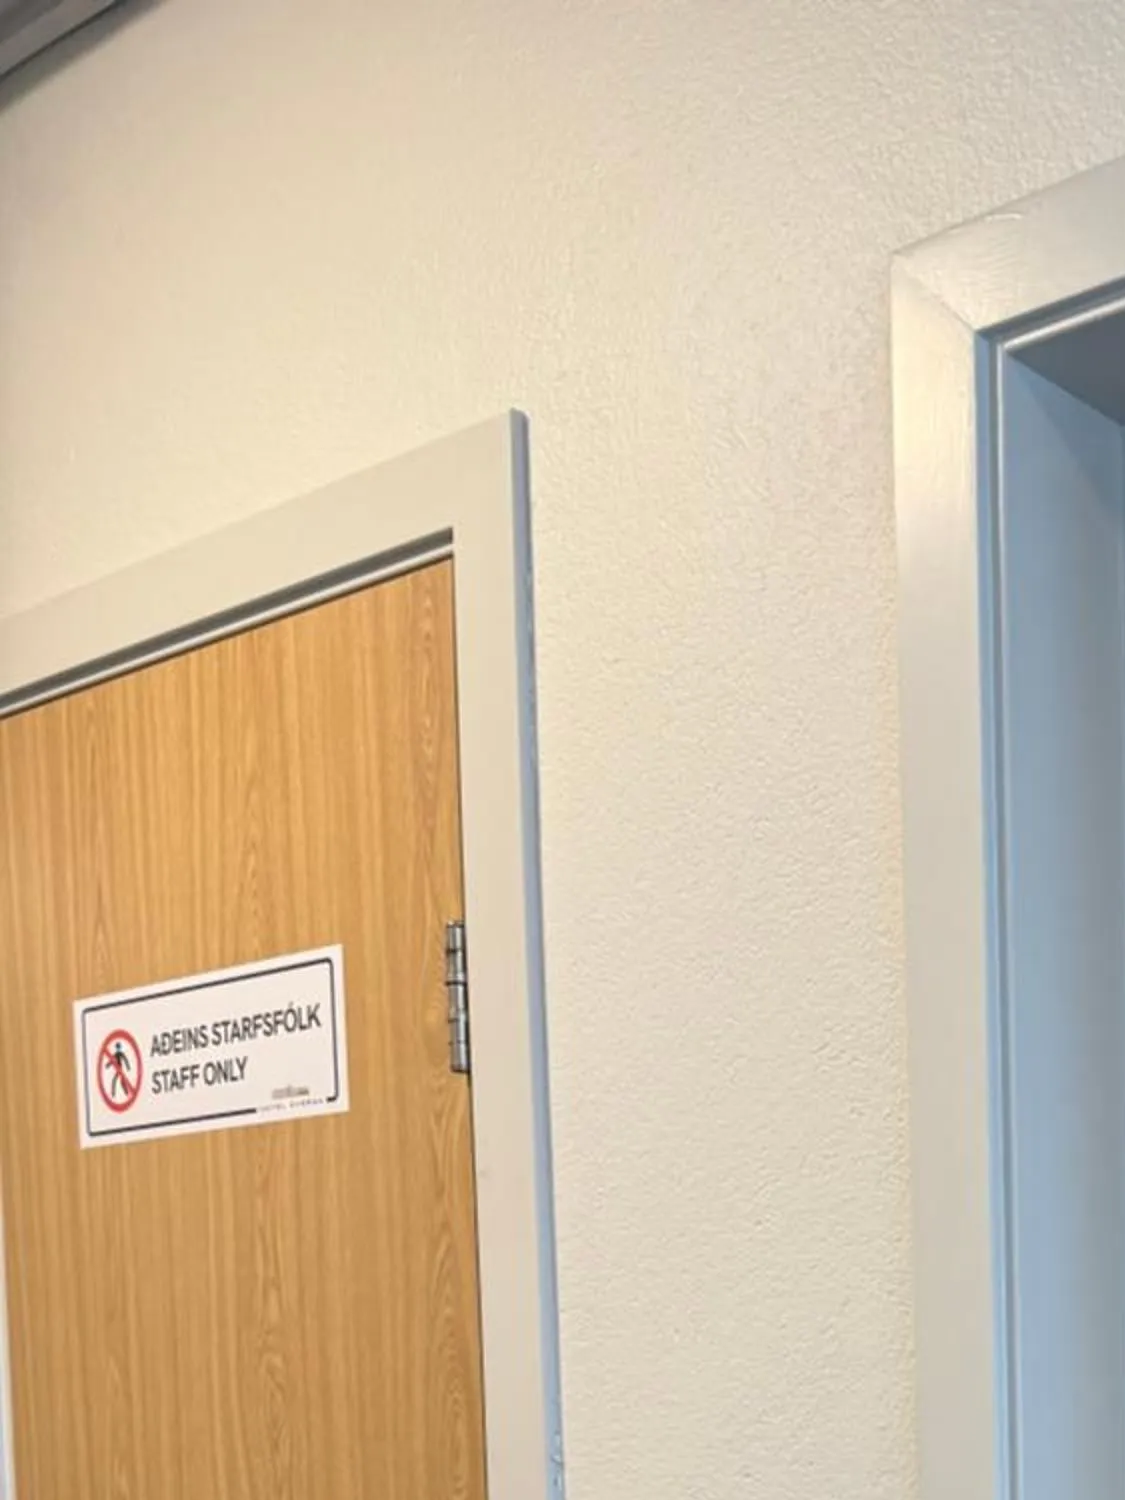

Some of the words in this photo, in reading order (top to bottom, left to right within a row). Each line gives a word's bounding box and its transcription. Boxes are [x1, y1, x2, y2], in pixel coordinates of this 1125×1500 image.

[151, 1027, 208, 1057] AÐEINS
[212, 1002, 321, 1045] STARFSFÓLK
[152, 1064, 200, 1094] STAFF
[204, 1056, 248, 1085] ONLY
